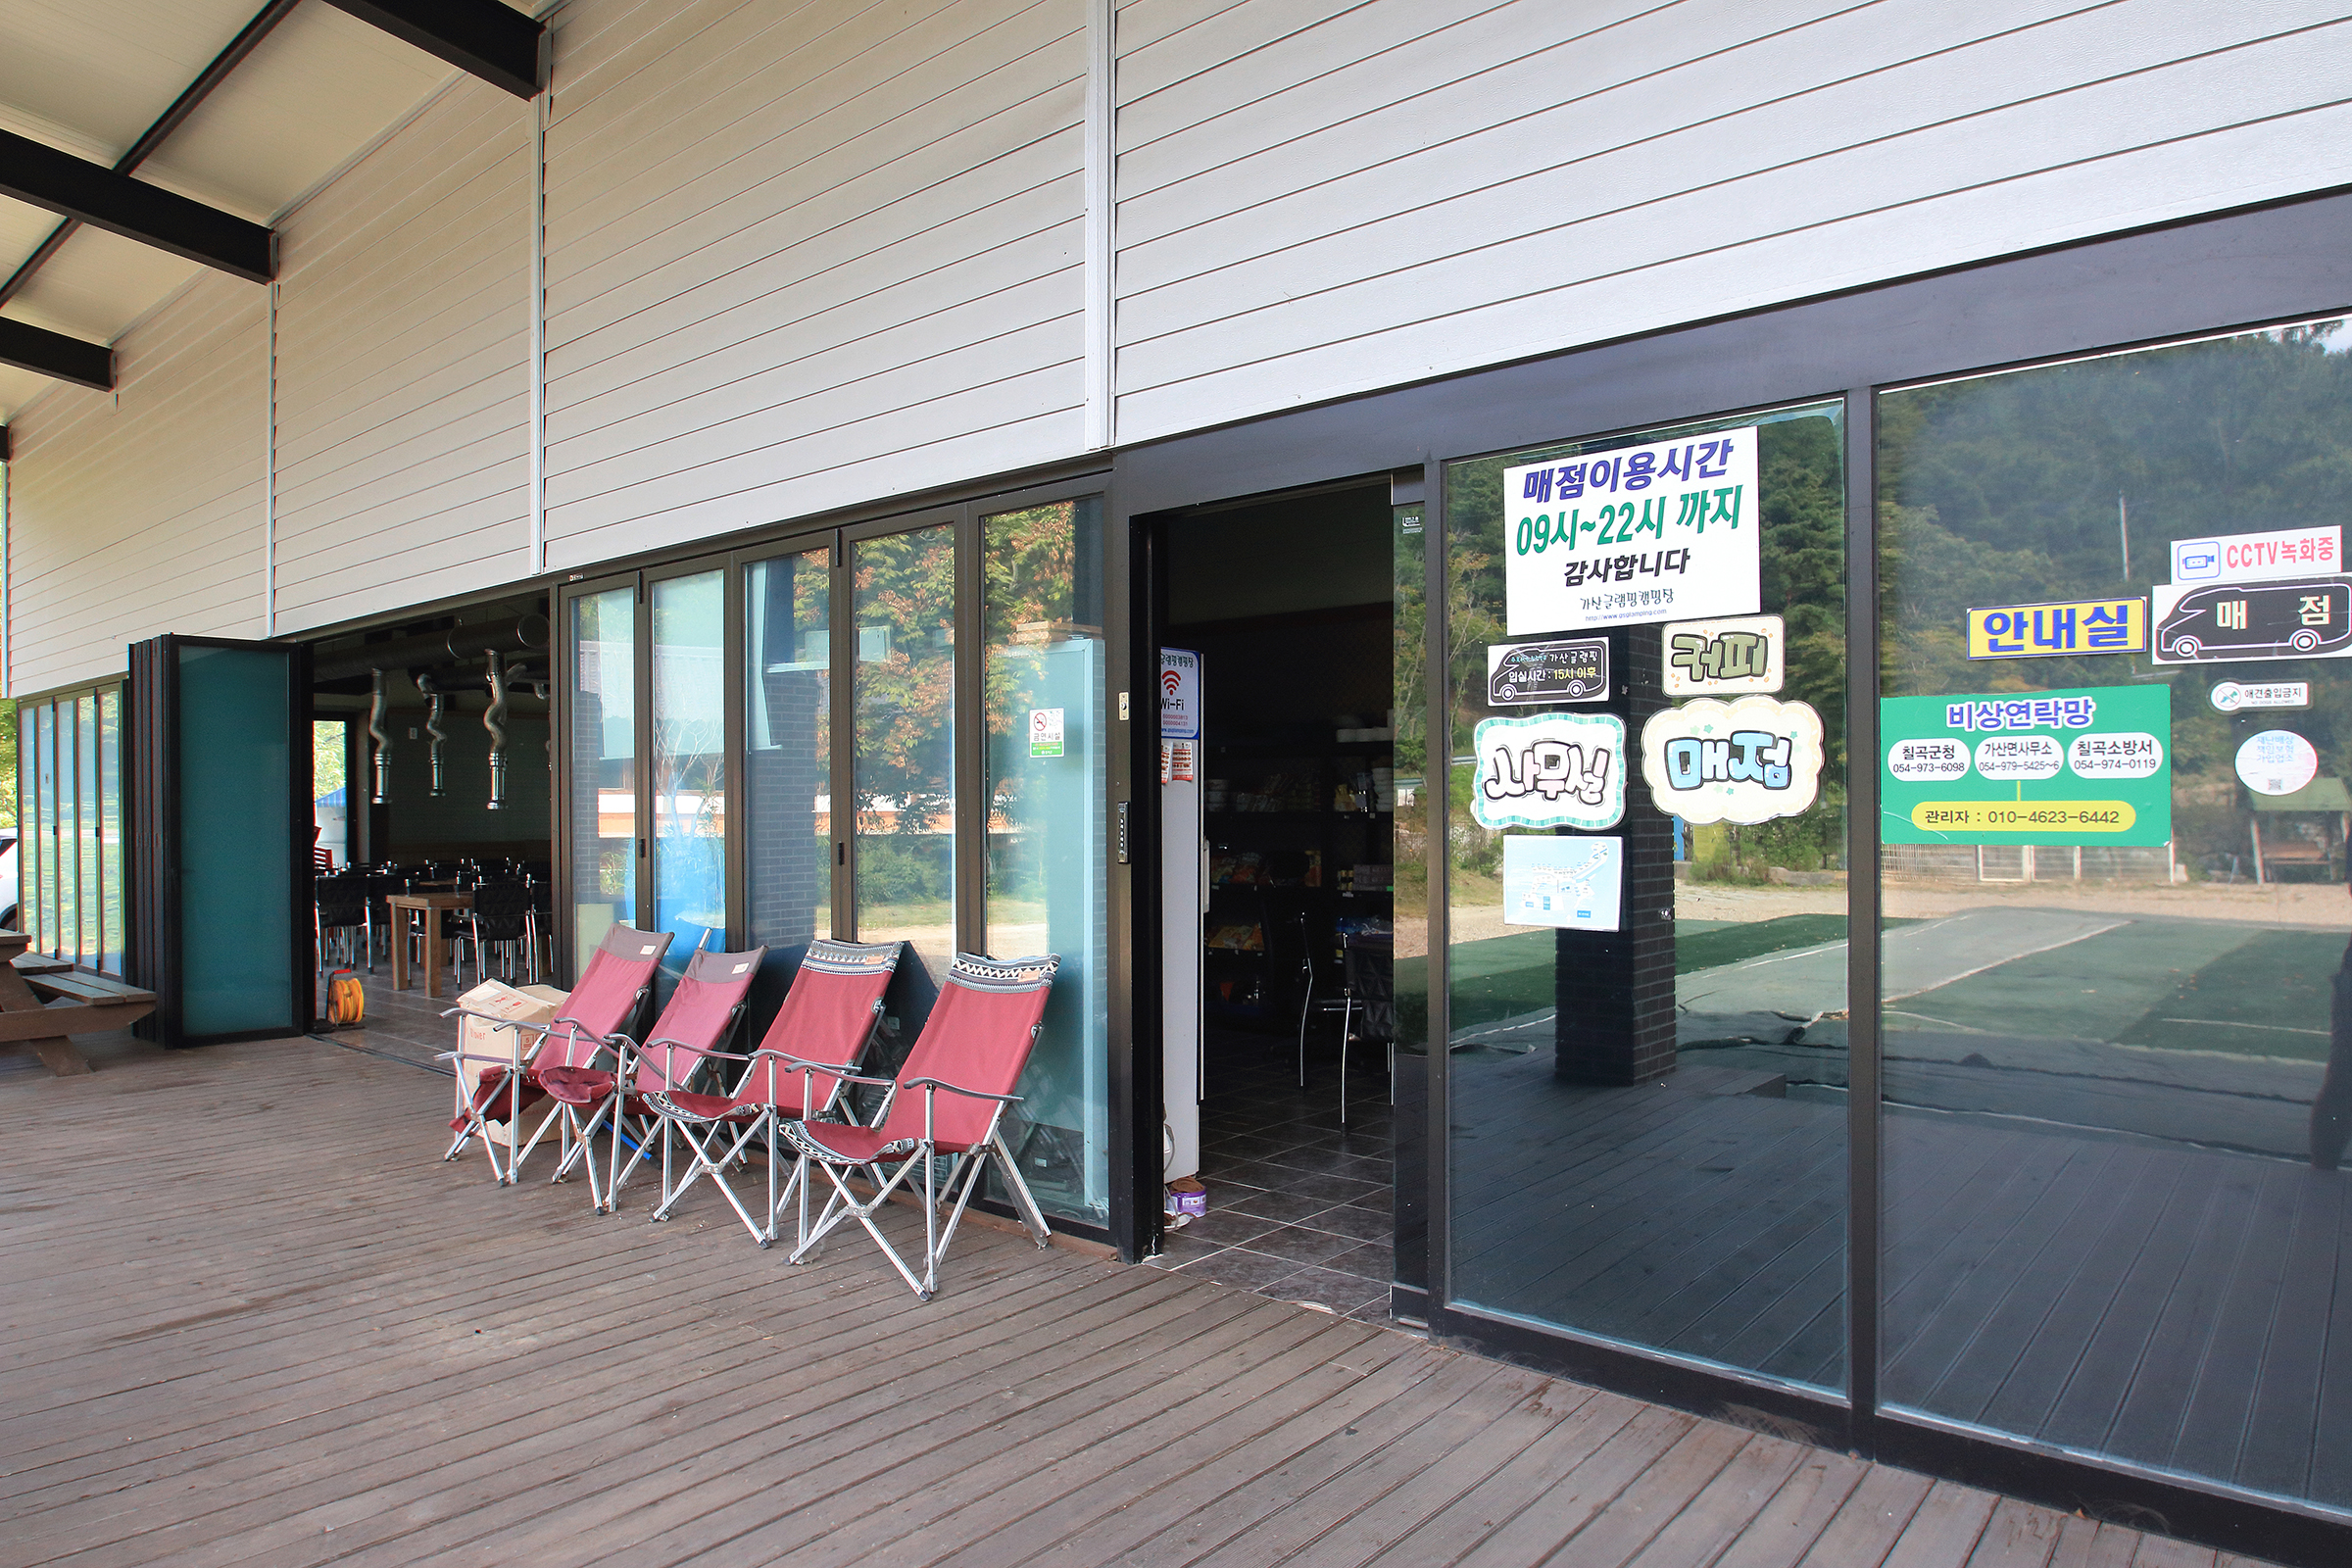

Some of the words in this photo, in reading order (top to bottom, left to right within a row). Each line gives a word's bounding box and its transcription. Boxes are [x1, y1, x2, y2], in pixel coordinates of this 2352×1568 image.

[1522, 438, 1735, 504] 매점이용시간
[1516, 496, 1667, 556] 09시~22시
[1676, 485, 1743, 534] 까지
[2226, 536, 2334, 569] CCTV녹화중
[1564, 548, 1691, 587] 감사합니다
[1580, 588, 1674, 611] 가산글램핑캠핑장
[1983, 604, 2130, 654] 안내실
[1671, 631, 1769, 682] 커피
[1553, 667, 1574, 680] 15시
[1576, 666, 1596, 678] 이후
[1160, 697, 1184, 710] Wi-Fi
[1947, 697, 2094, 731] 비상연락망
[1902, 745, 1955, 760] 칠곡군청
[1984, 741, 2052, 758] 가산면사무소
[2077, 740, 2153, 756] 칠곡소방서
[1666, 730, 1792, 790] 매점
[1892, 762, 1965, 773] 054-973-6098
[1979, 760, 2060, 771] 054-979-5425~6
[2074, 759, 2156, 770] 054-974-0119
[1484, 739, 1610, 806] 사무실
[1925, 809, 1970, 824] 관리자
[1987, 810, 2120, 824] 010-4623-6442
